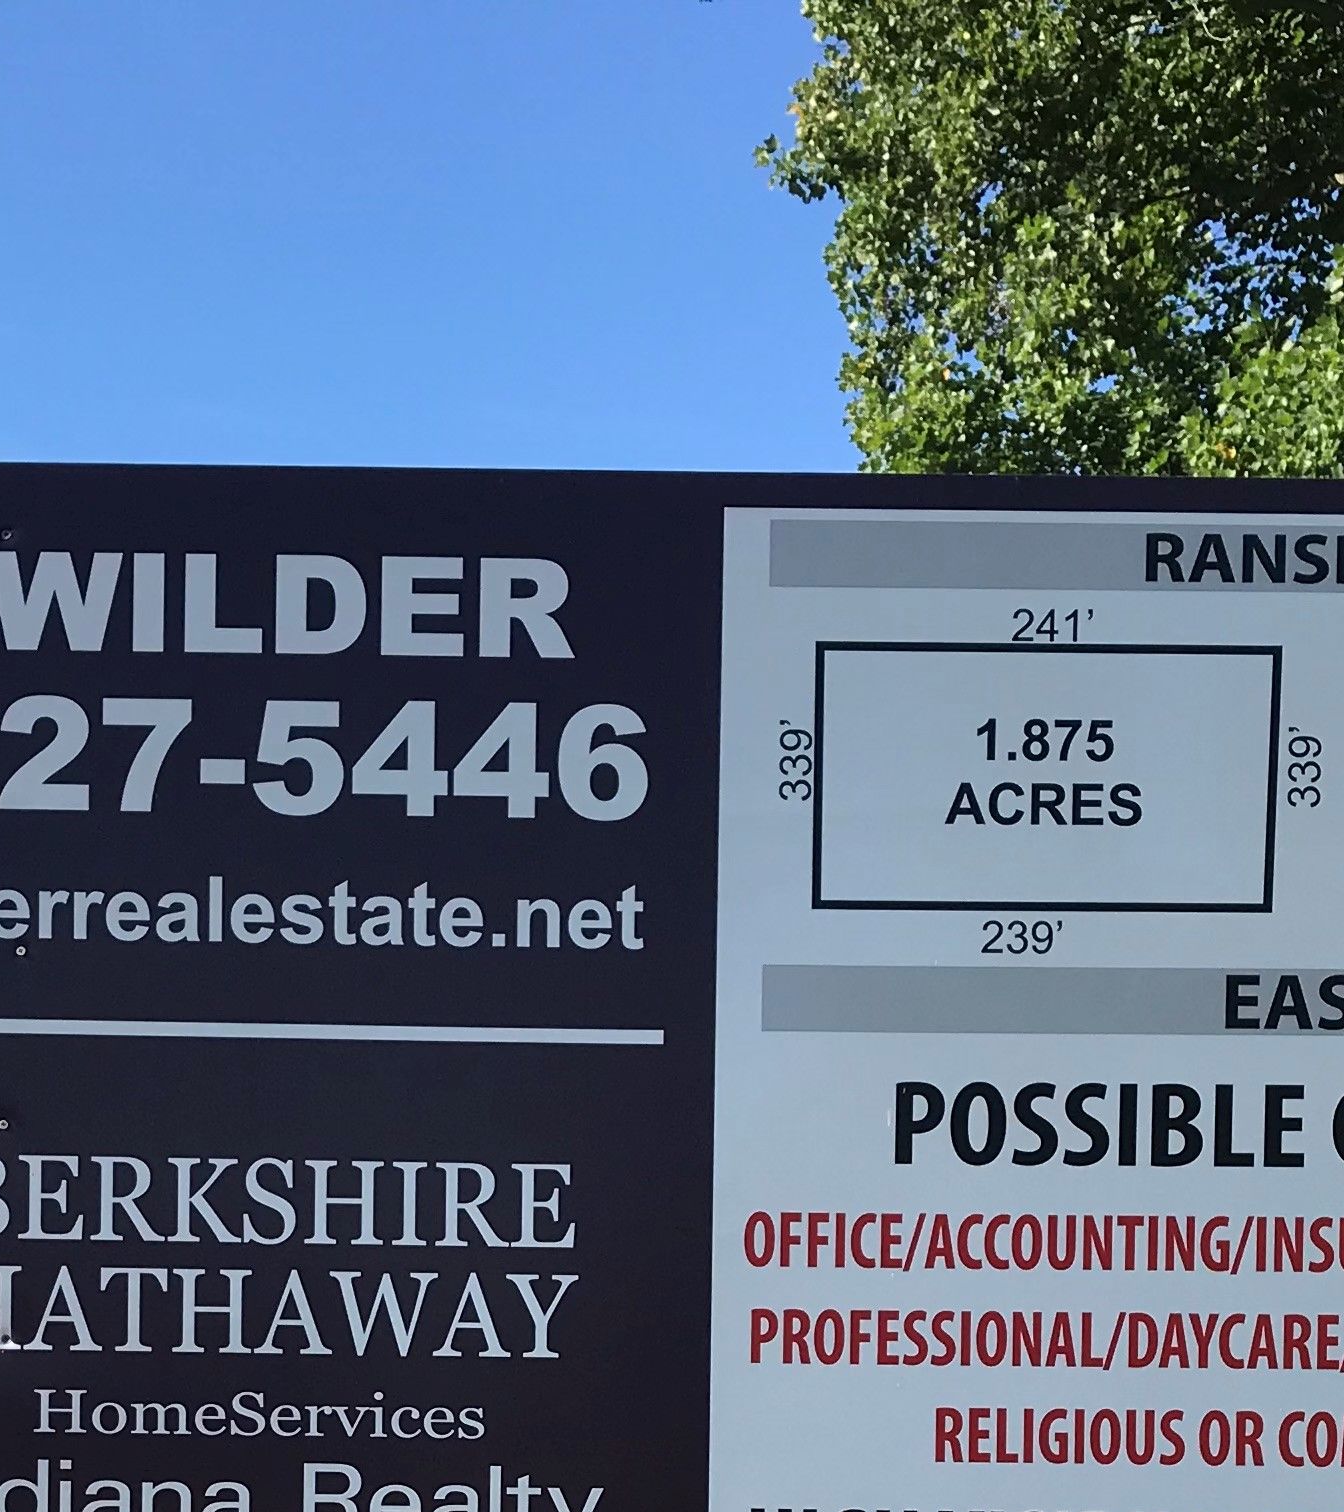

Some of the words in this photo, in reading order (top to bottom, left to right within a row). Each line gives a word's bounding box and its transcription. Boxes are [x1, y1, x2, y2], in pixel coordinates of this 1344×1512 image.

[977, 719, 1114, 762] 1.875
[945, 782, 1142, 826] ACRES
[895, 1082, 1304, 1167] POSSIBLE
[34, 1389, 484, 1439] HomeServices
[935, 1408, 1185, 1465] RELIGIOUS
[1199, 1410, 1264, 1466] OR
